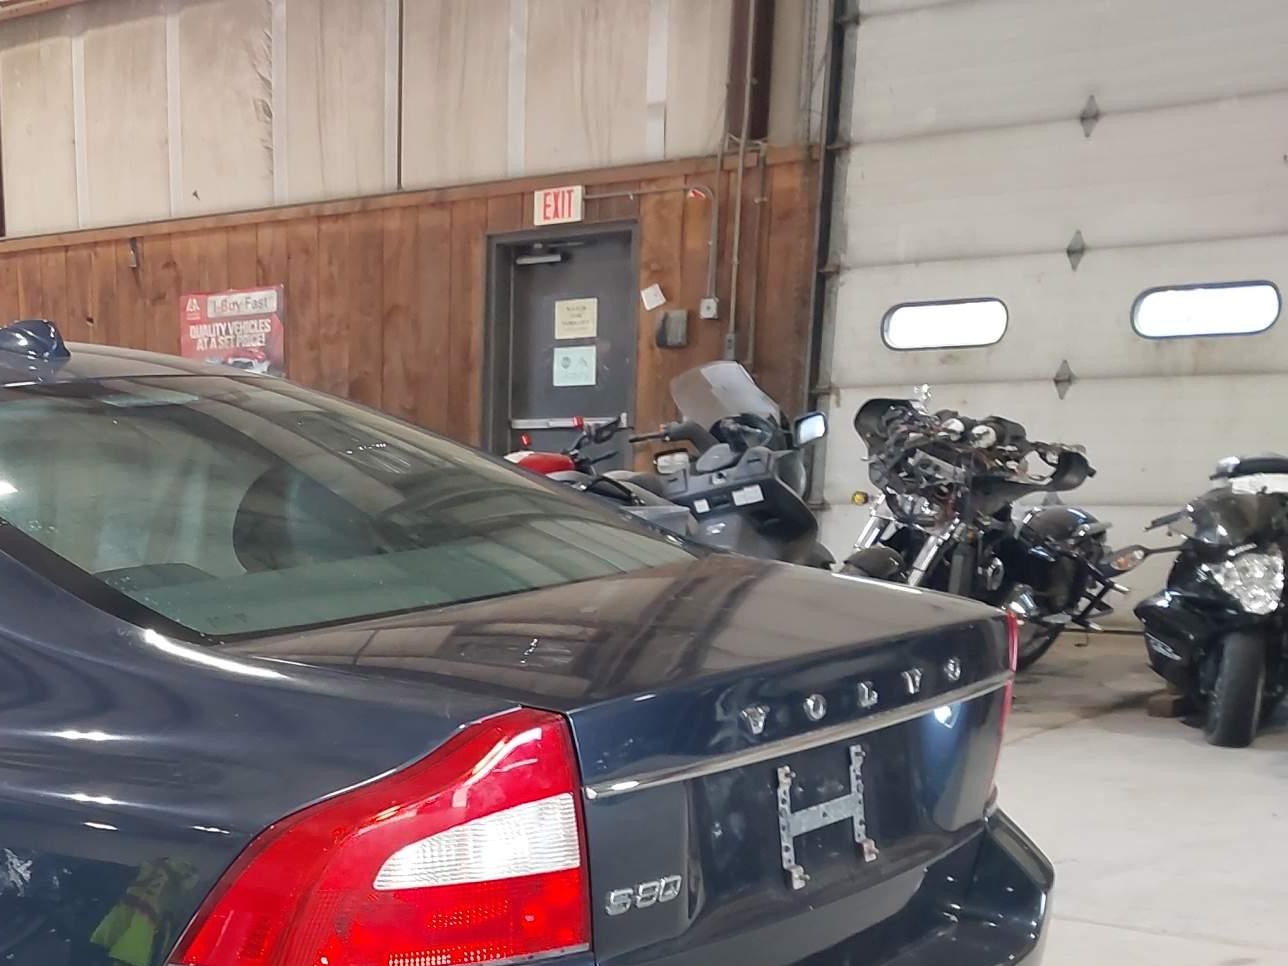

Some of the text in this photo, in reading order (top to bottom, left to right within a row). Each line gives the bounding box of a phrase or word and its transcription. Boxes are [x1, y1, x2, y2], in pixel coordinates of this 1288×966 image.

[543, 189, 574, 220] EXIT
[740, 655, 962, 736] VOLVO
[605, 874, 682, 916] S80
